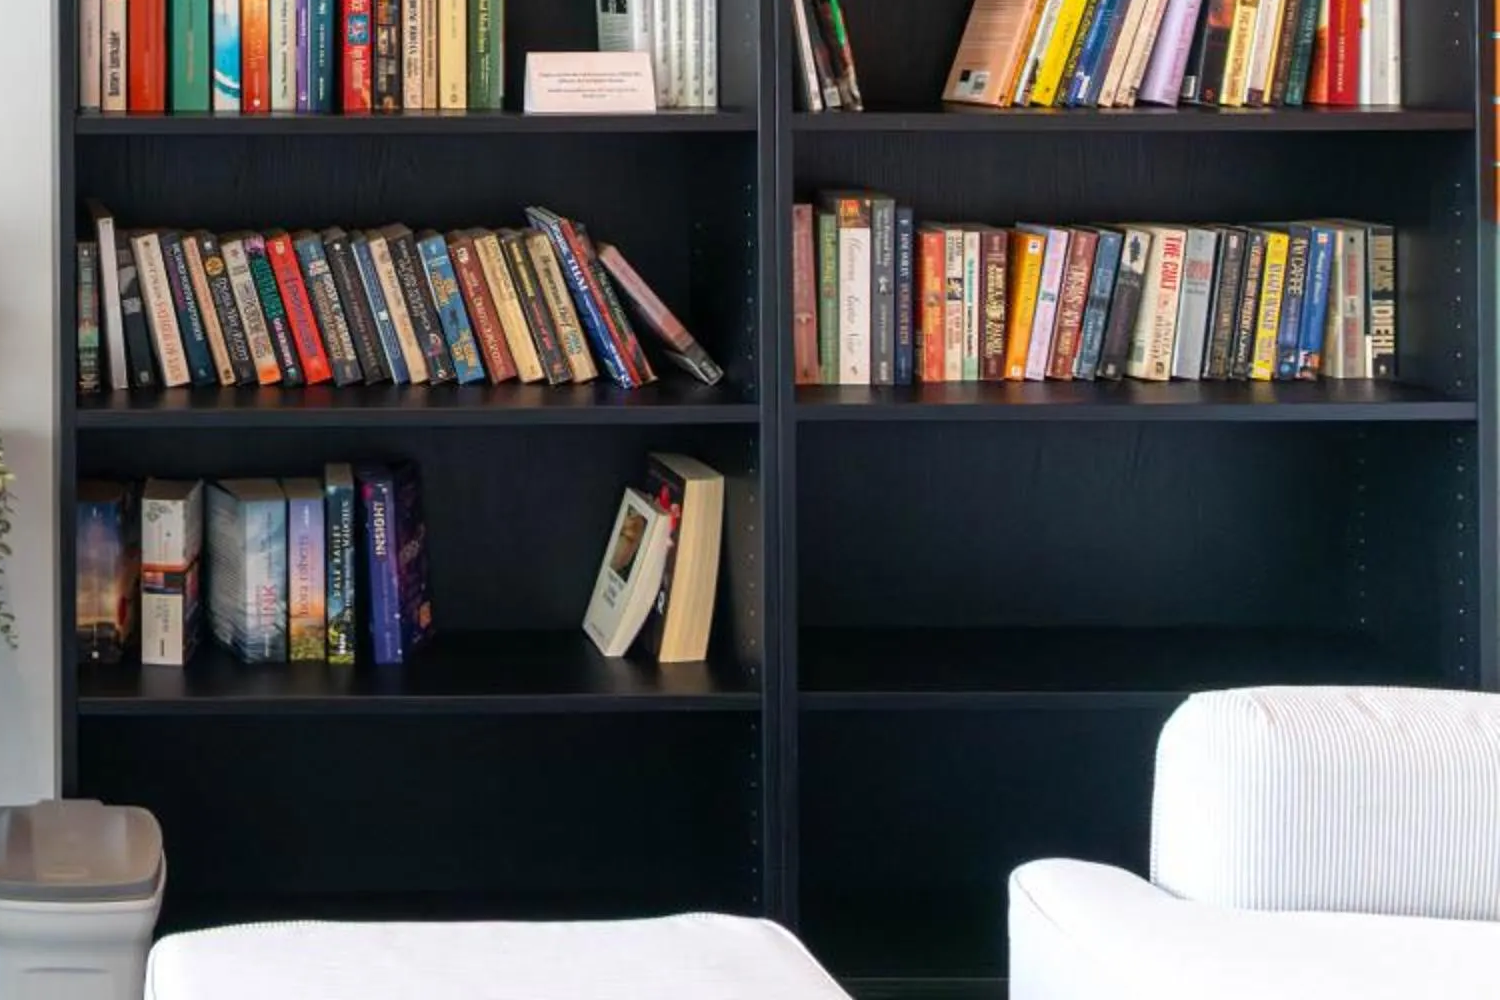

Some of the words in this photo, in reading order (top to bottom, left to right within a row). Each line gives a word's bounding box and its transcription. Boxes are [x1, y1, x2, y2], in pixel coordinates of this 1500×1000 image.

[1163, 236, 1182, 258] THE
[1372, 305, 1394, 358] DIEHL
[373, 501, 387, 556] INSIGHT
